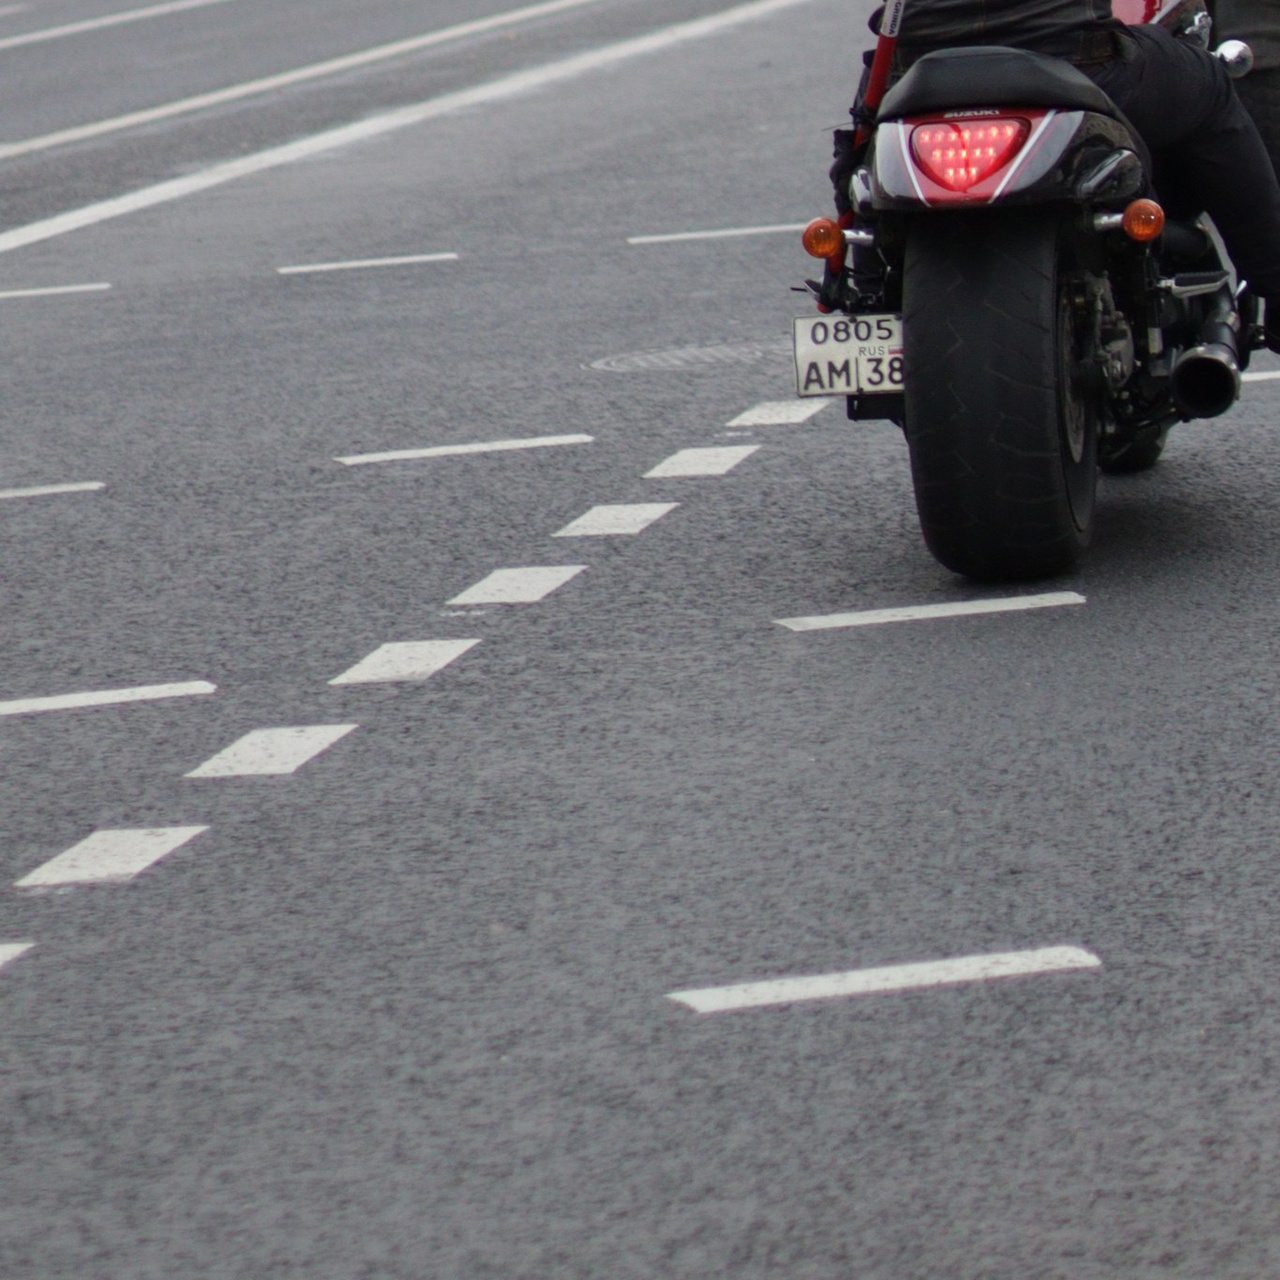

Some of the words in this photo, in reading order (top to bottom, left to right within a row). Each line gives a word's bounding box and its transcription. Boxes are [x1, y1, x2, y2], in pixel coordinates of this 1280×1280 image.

[944, 110, 1000, 118] SUZUKI
[811, 319, 893, 345] 0805
[858, 346, 885, 357] RUS
[867, 357, 904, 385] 38
